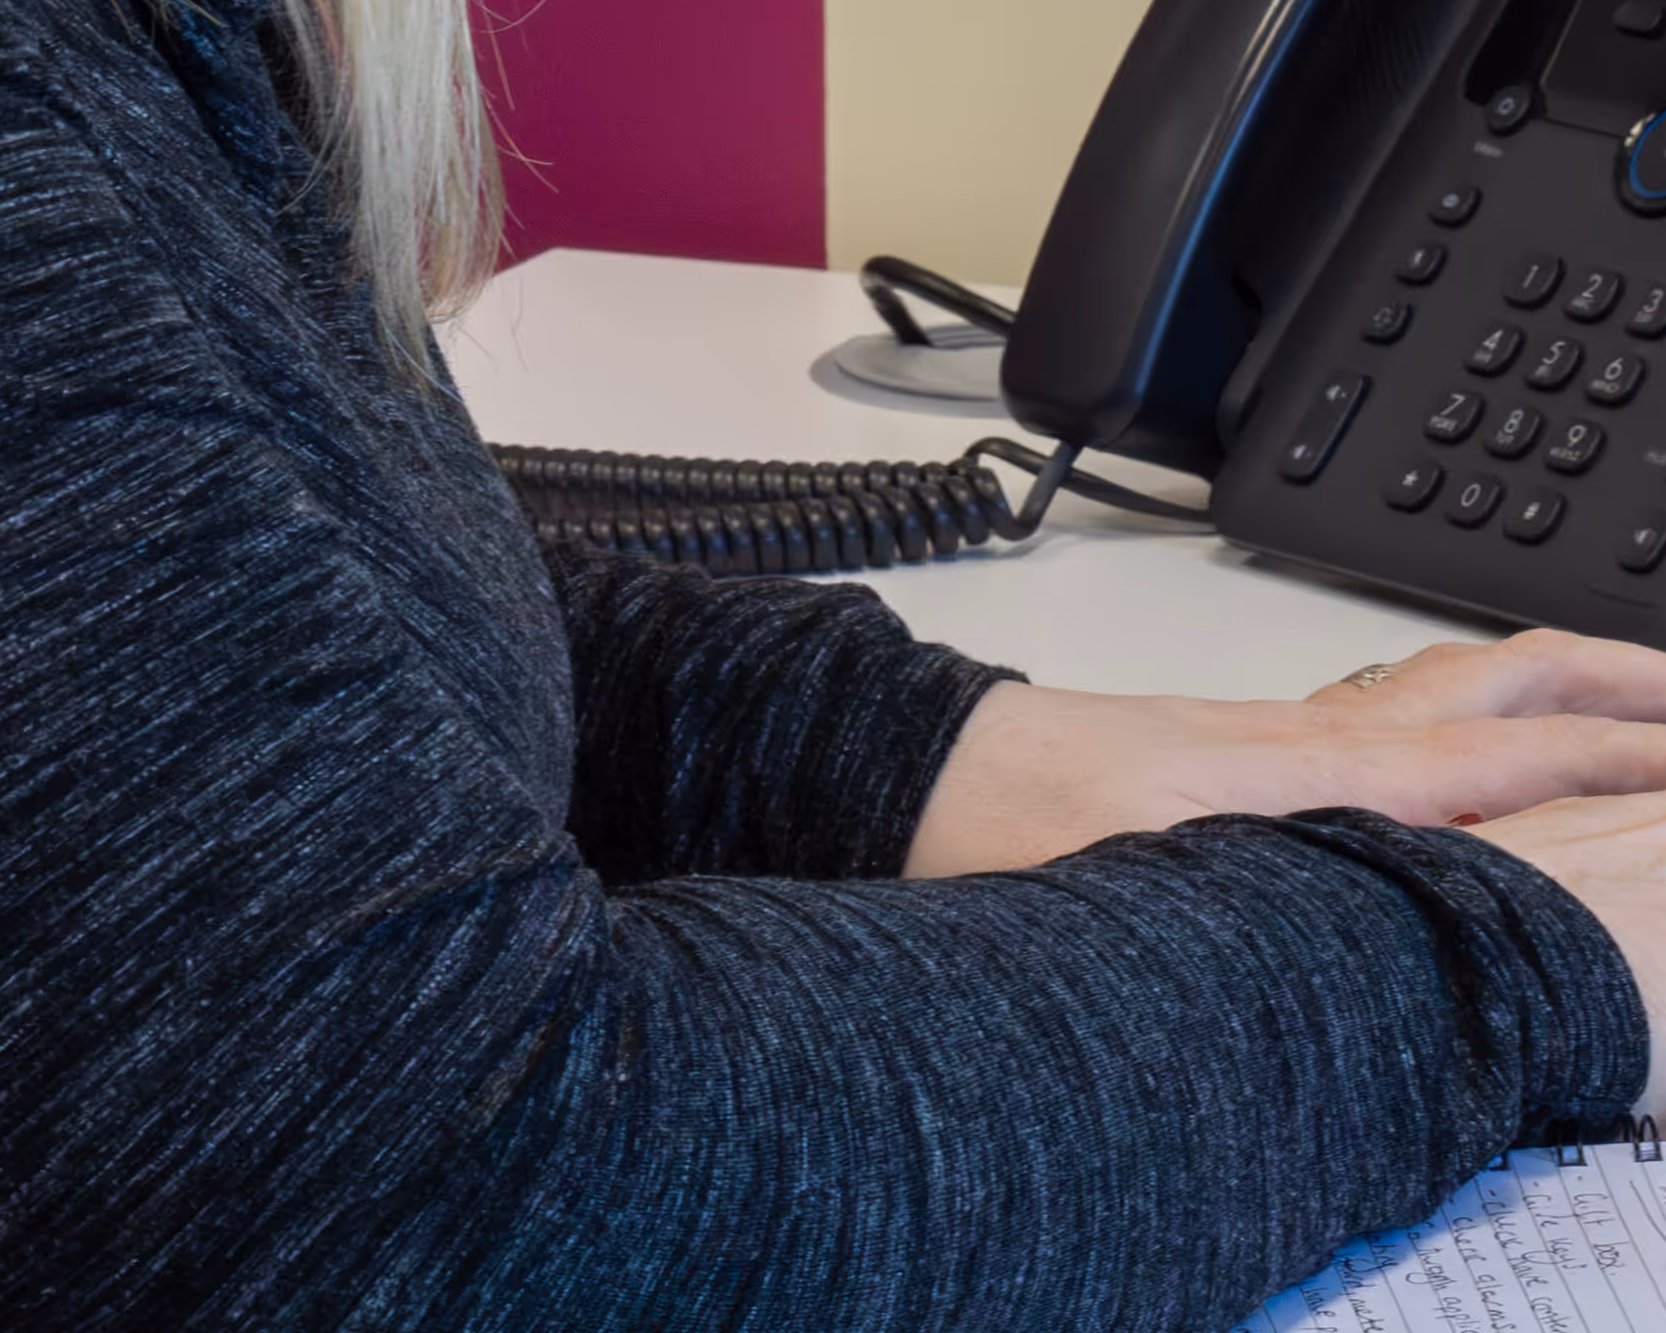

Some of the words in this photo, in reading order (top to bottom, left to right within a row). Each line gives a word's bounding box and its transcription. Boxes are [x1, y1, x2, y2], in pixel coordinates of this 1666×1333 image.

[1522, 265, 1538, 287] 1
[1582, 275, 1602, 299] 2
[1644, 289, 1663, 314] 3
[1483, 329, 1502, 350] 4
[1544, 341, 1567, 365] 5
[1605, 358, 1623, 379] 6
[1442, 395, 1465, 415] 7
[1504, 409, 1523, 432] 8
[1568, 425, 1586, 445] 9
[1461, 483, 1480, 506] 0
